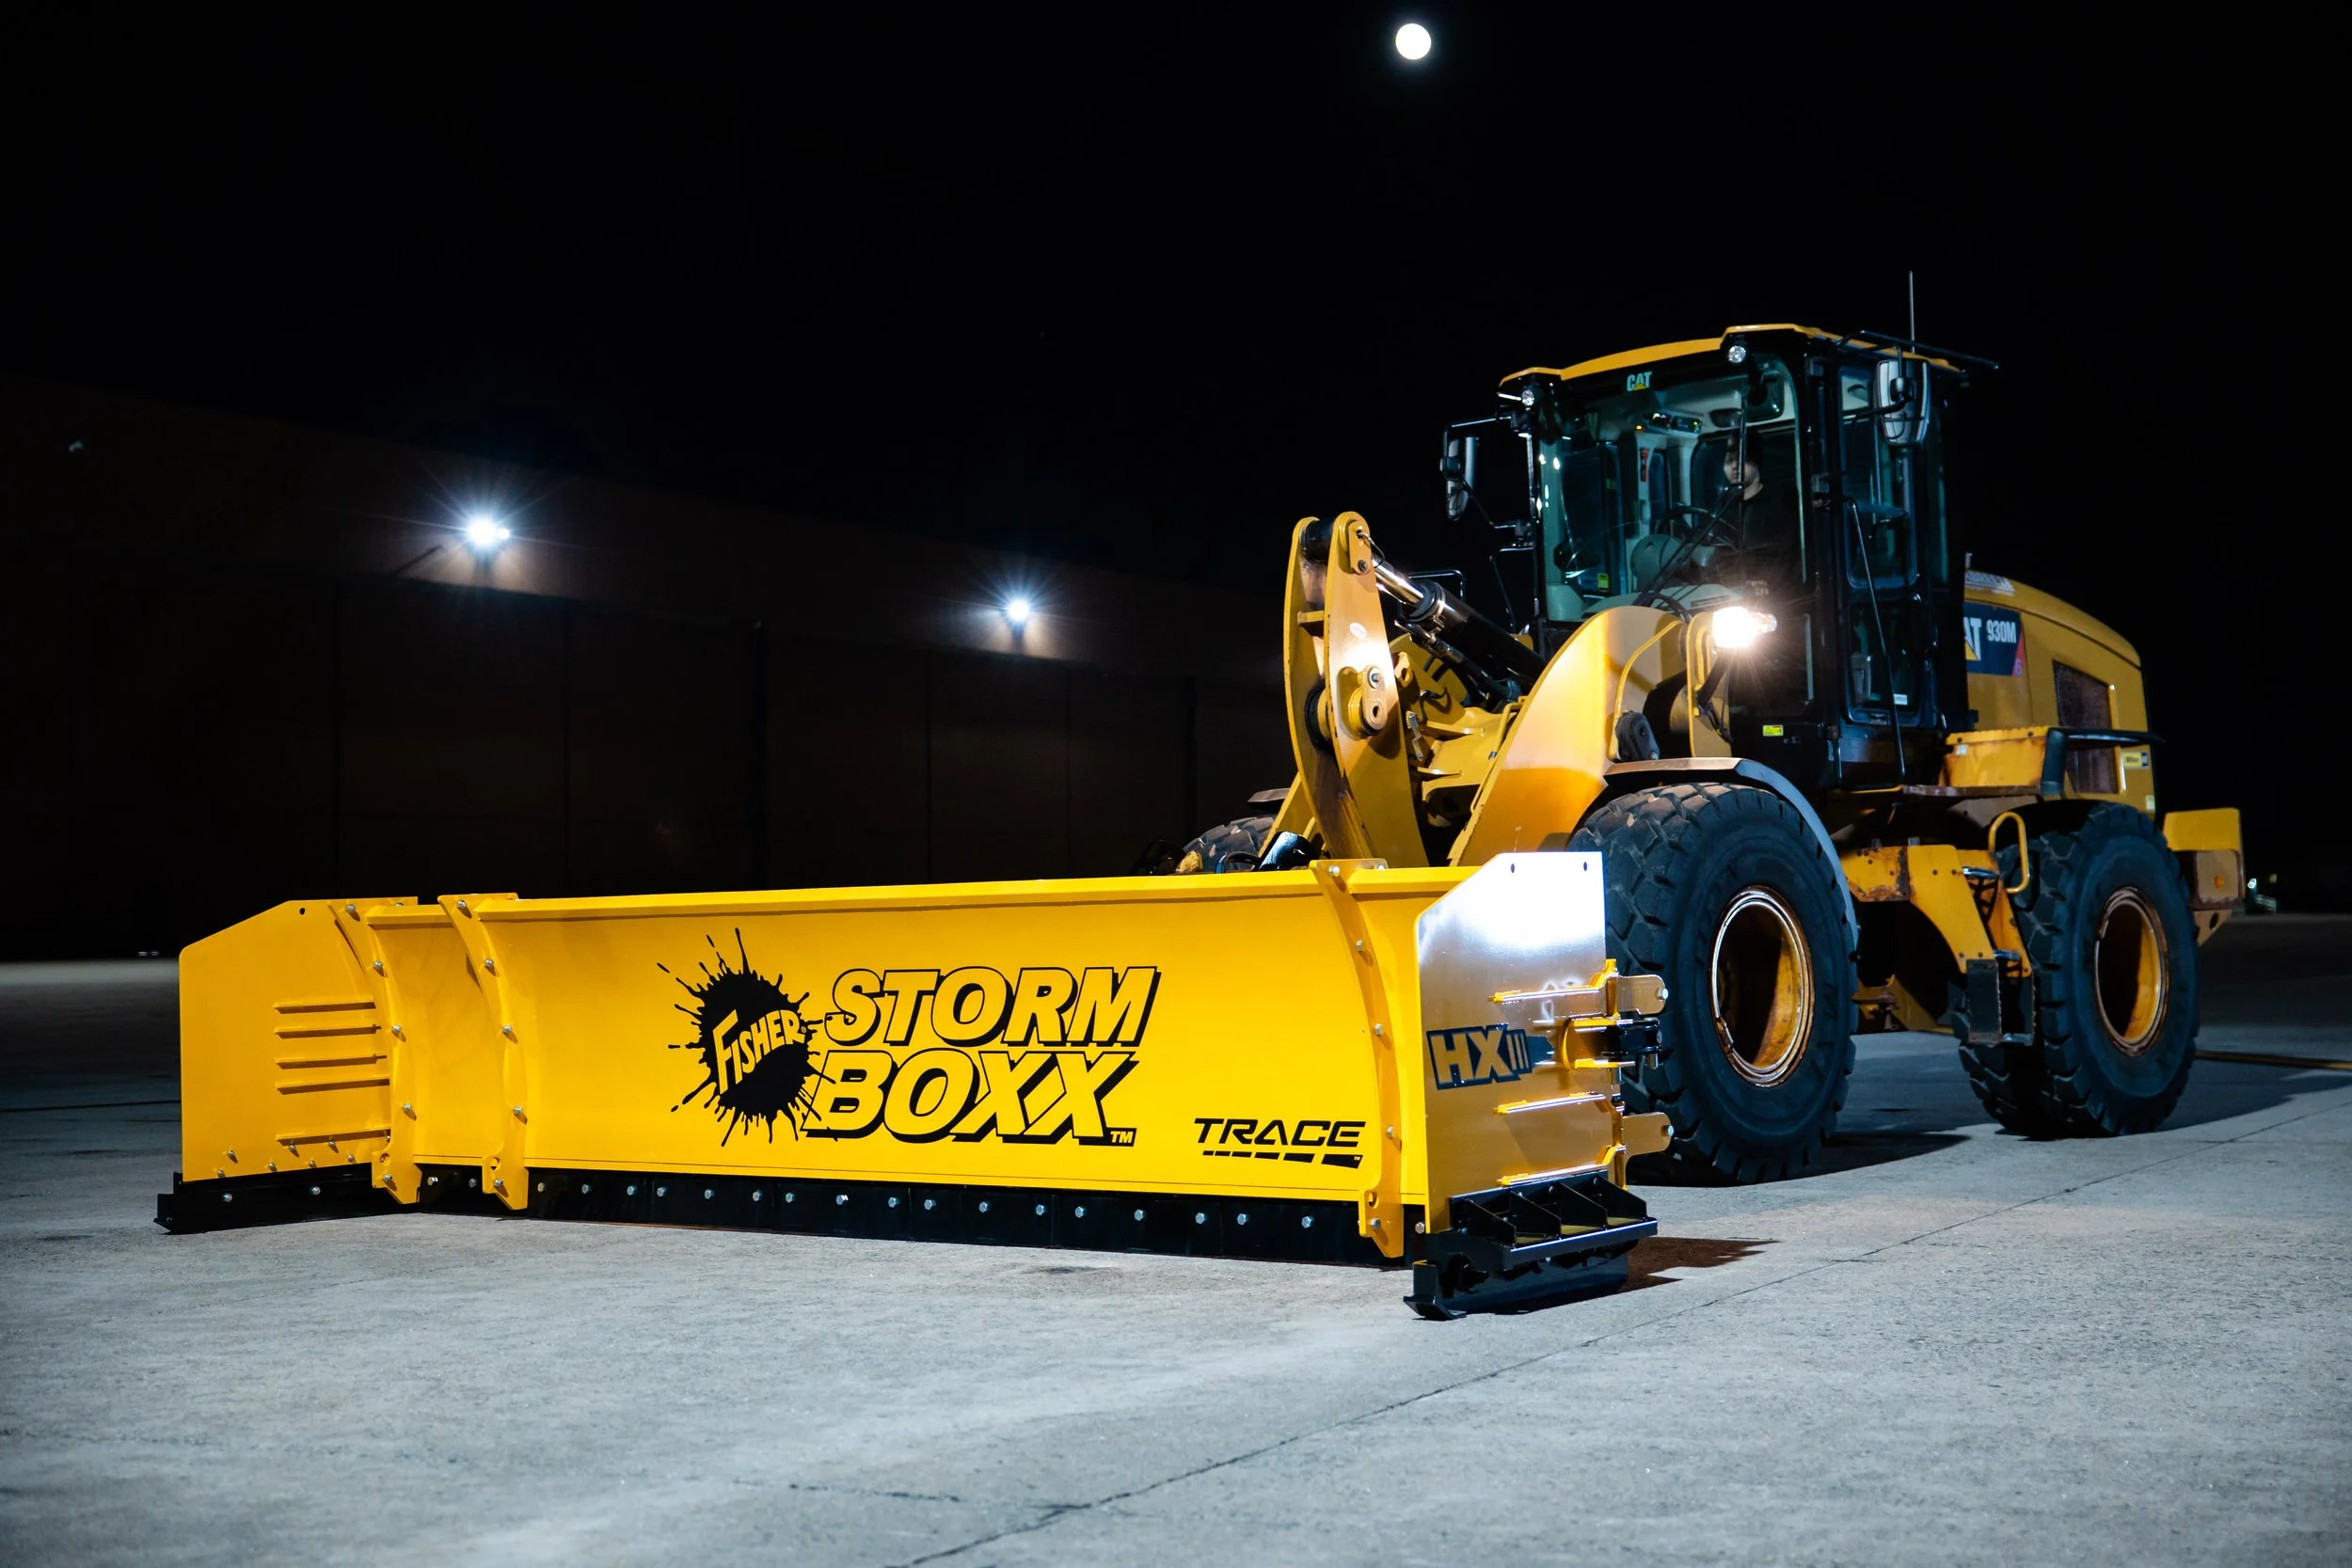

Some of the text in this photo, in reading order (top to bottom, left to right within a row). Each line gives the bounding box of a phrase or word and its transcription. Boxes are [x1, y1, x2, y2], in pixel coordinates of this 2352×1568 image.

[1627, 371, 1653, 392] CAT
[1986, 619, 2017, 643] 930M
[824, 966, 1162, 1048] STORM
[800, 1047, 1140, 1147] BOXX
[1194, 1117, 1367, 1148] TRACE
